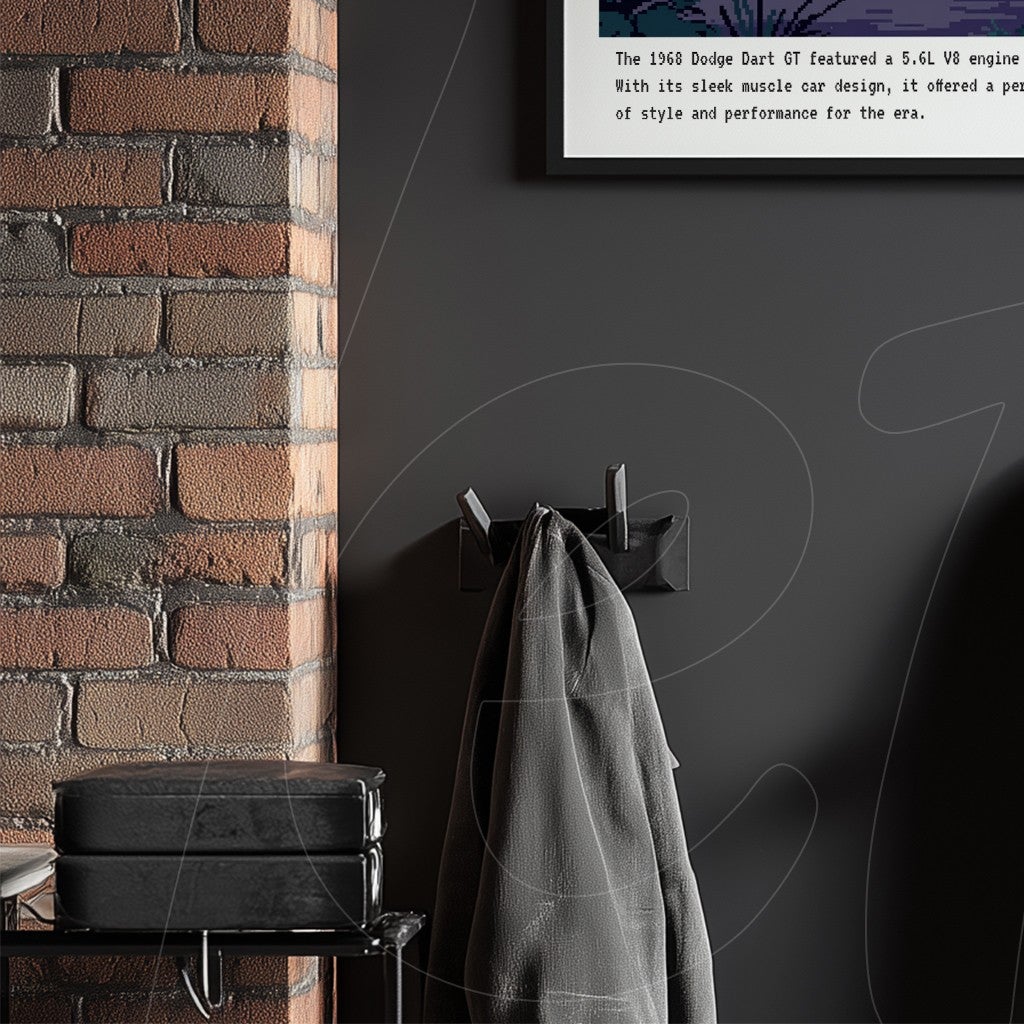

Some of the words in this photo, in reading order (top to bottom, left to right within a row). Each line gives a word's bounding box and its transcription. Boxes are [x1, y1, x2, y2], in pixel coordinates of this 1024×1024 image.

[615, 51, 641, 66] The
[649, 51, 683, 66] 1968
[691, 51, 734, 69] Dodge
[741, 51, 775, 66] Dart
[783, 50, 801, 66] GT
[810, 50, 877, 66] featured
[884, 54, 894, 66] a
[902, 50, 936, 66] 5.6L
[943, 50, 960, 66] V8
[968, 50, 1020, 69] engine
[615, 78, 650, 93] With
[658, 78, 683, 93] its
[691, 78, 734, 93] sleek
[741, 78, 793, 93] muscle
[800, 81, 826, 93] car
[834, 78, 891, 97] design,
[902, 78, 918, 93] it
[926, 78, 978, 93] offered
[985, 81, 995, 93] a
[615, 106, 632, 120] of
[641, 106, 683, 124] style
[691, 106, 717, 120] and
[724, 106, 818, 124] performance
[826, 105, 852, 120] for
[859, 105, 885, 120] the
[893, 108, 925, 120] era.
